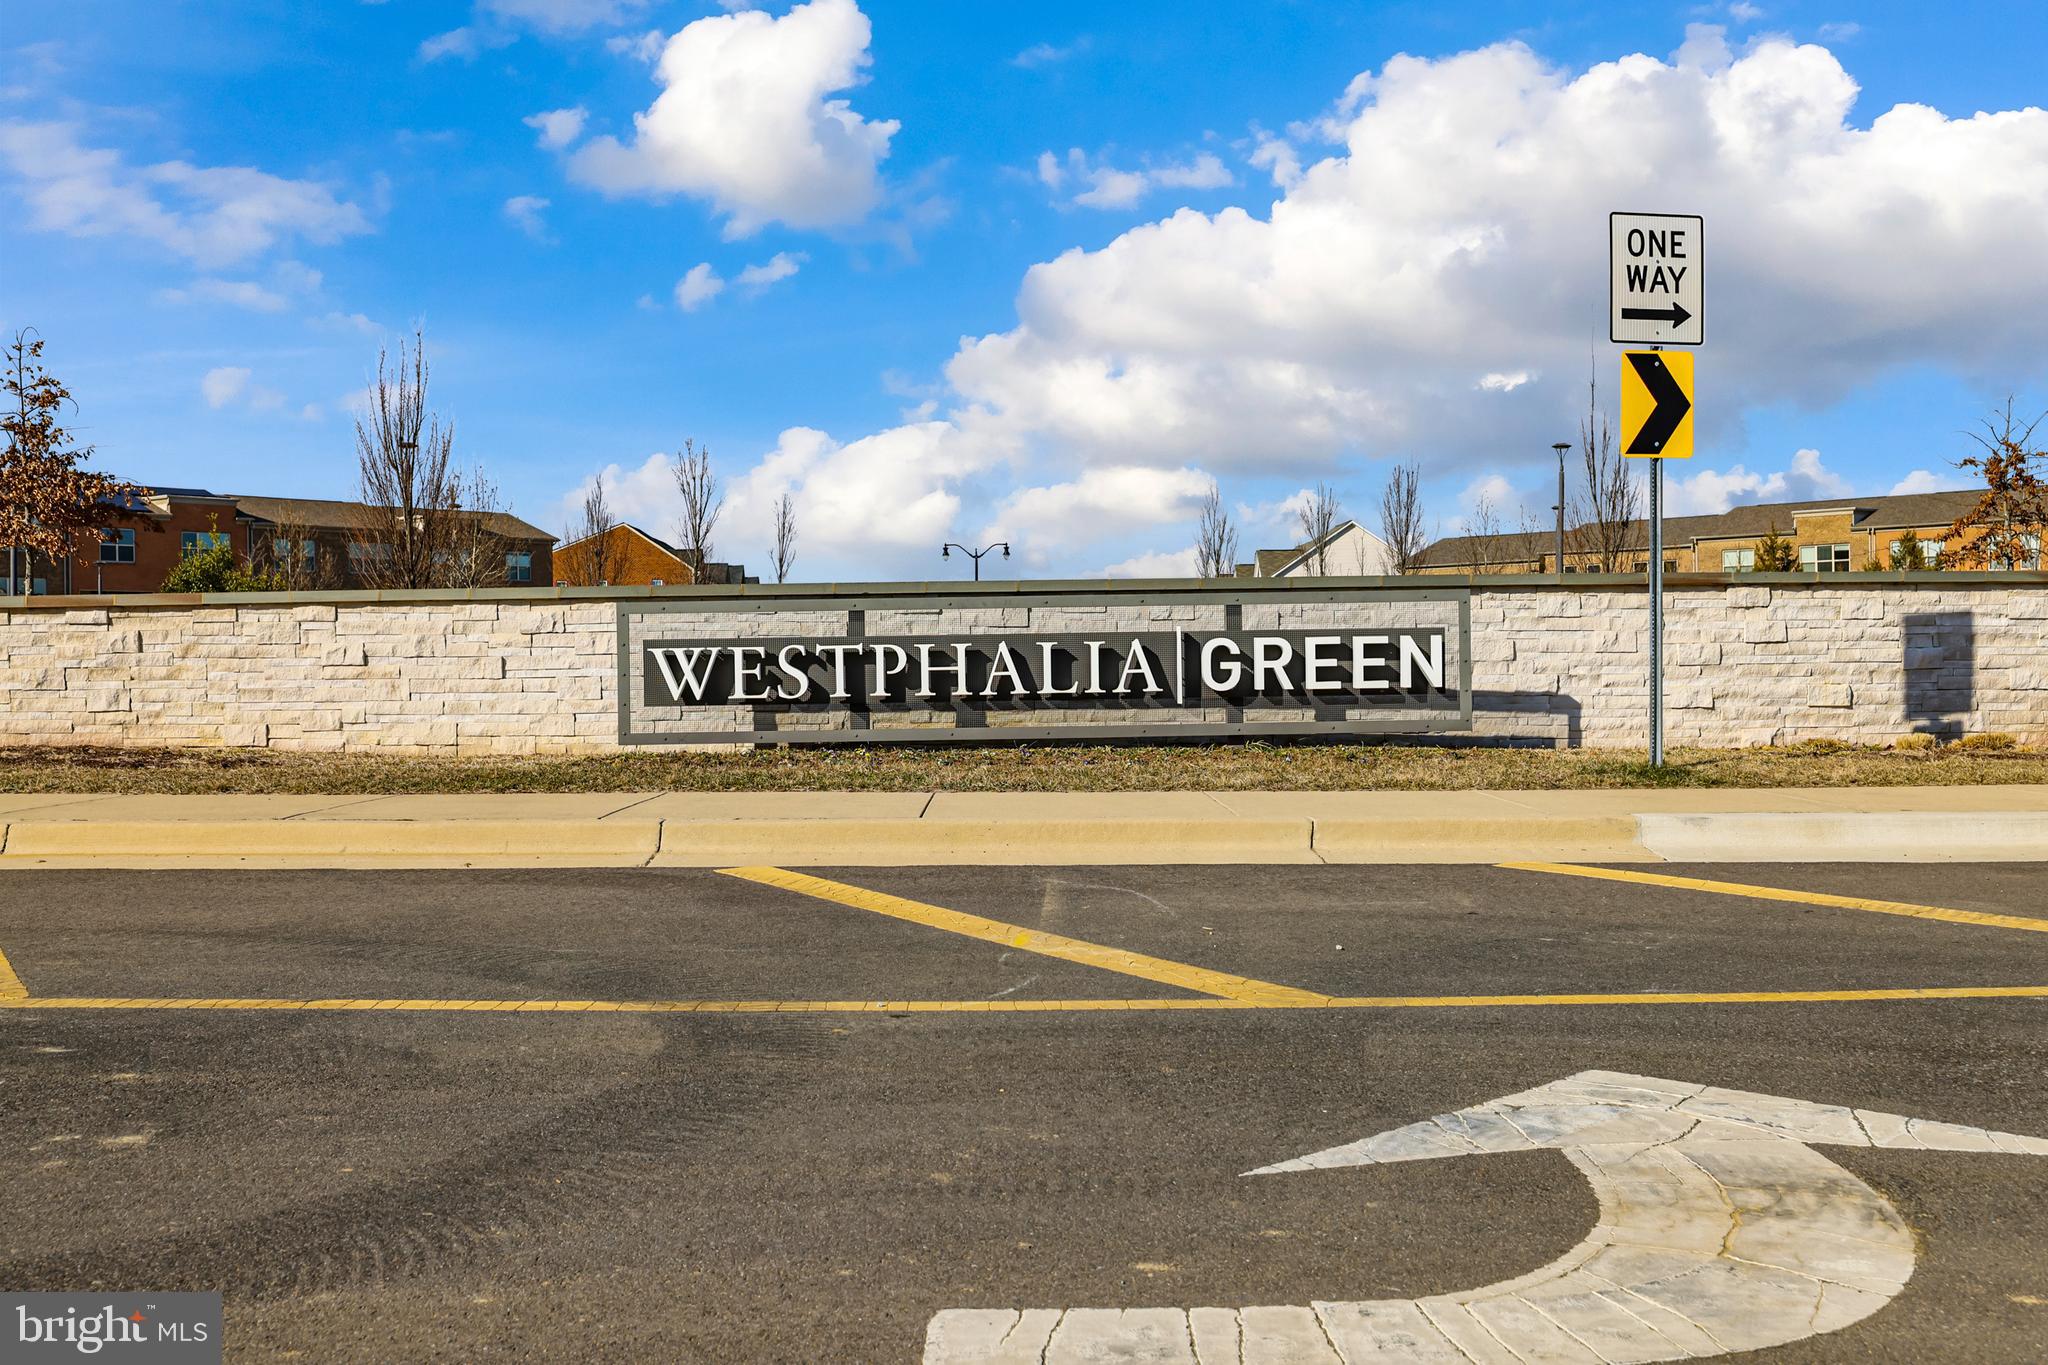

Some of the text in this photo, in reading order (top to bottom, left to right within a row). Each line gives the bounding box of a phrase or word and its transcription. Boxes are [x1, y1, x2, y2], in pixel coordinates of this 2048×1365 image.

[1627, 228, 1687, 258] ONE
[1626, 264, 1688, 294] WAY
[646, 634, 1443, 703] WESTPHALIA GREEN
